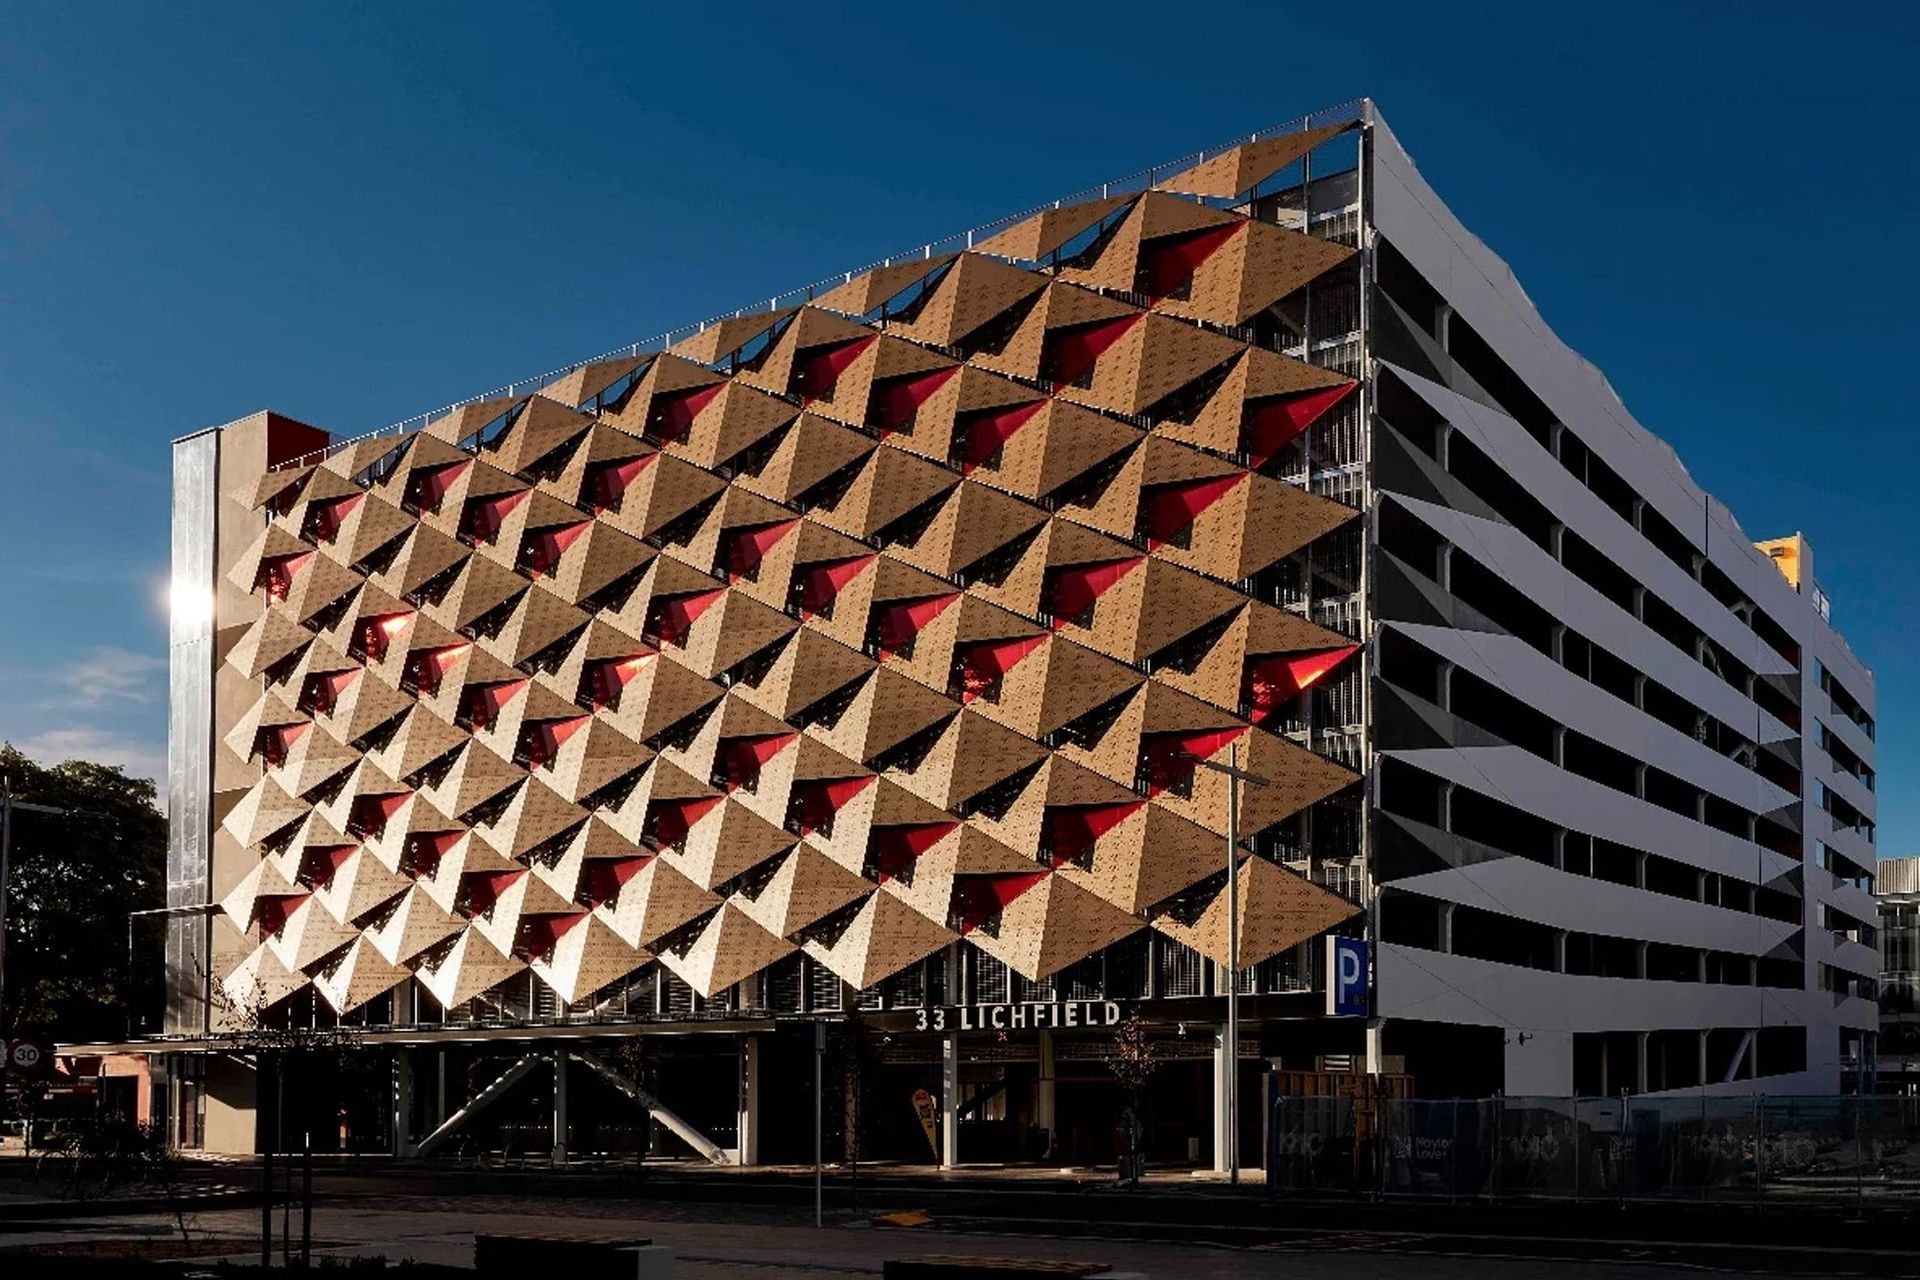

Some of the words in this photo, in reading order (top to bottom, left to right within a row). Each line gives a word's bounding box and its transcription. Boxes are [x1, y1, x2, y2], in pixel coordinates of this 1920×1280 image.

[1339, 947, 1360, 1004] P
[914, 1008, 944, 1031] 33
[961, 1003, 1120, 1030] LICHFIELD
[16, 1048, 36, 1060] 30
